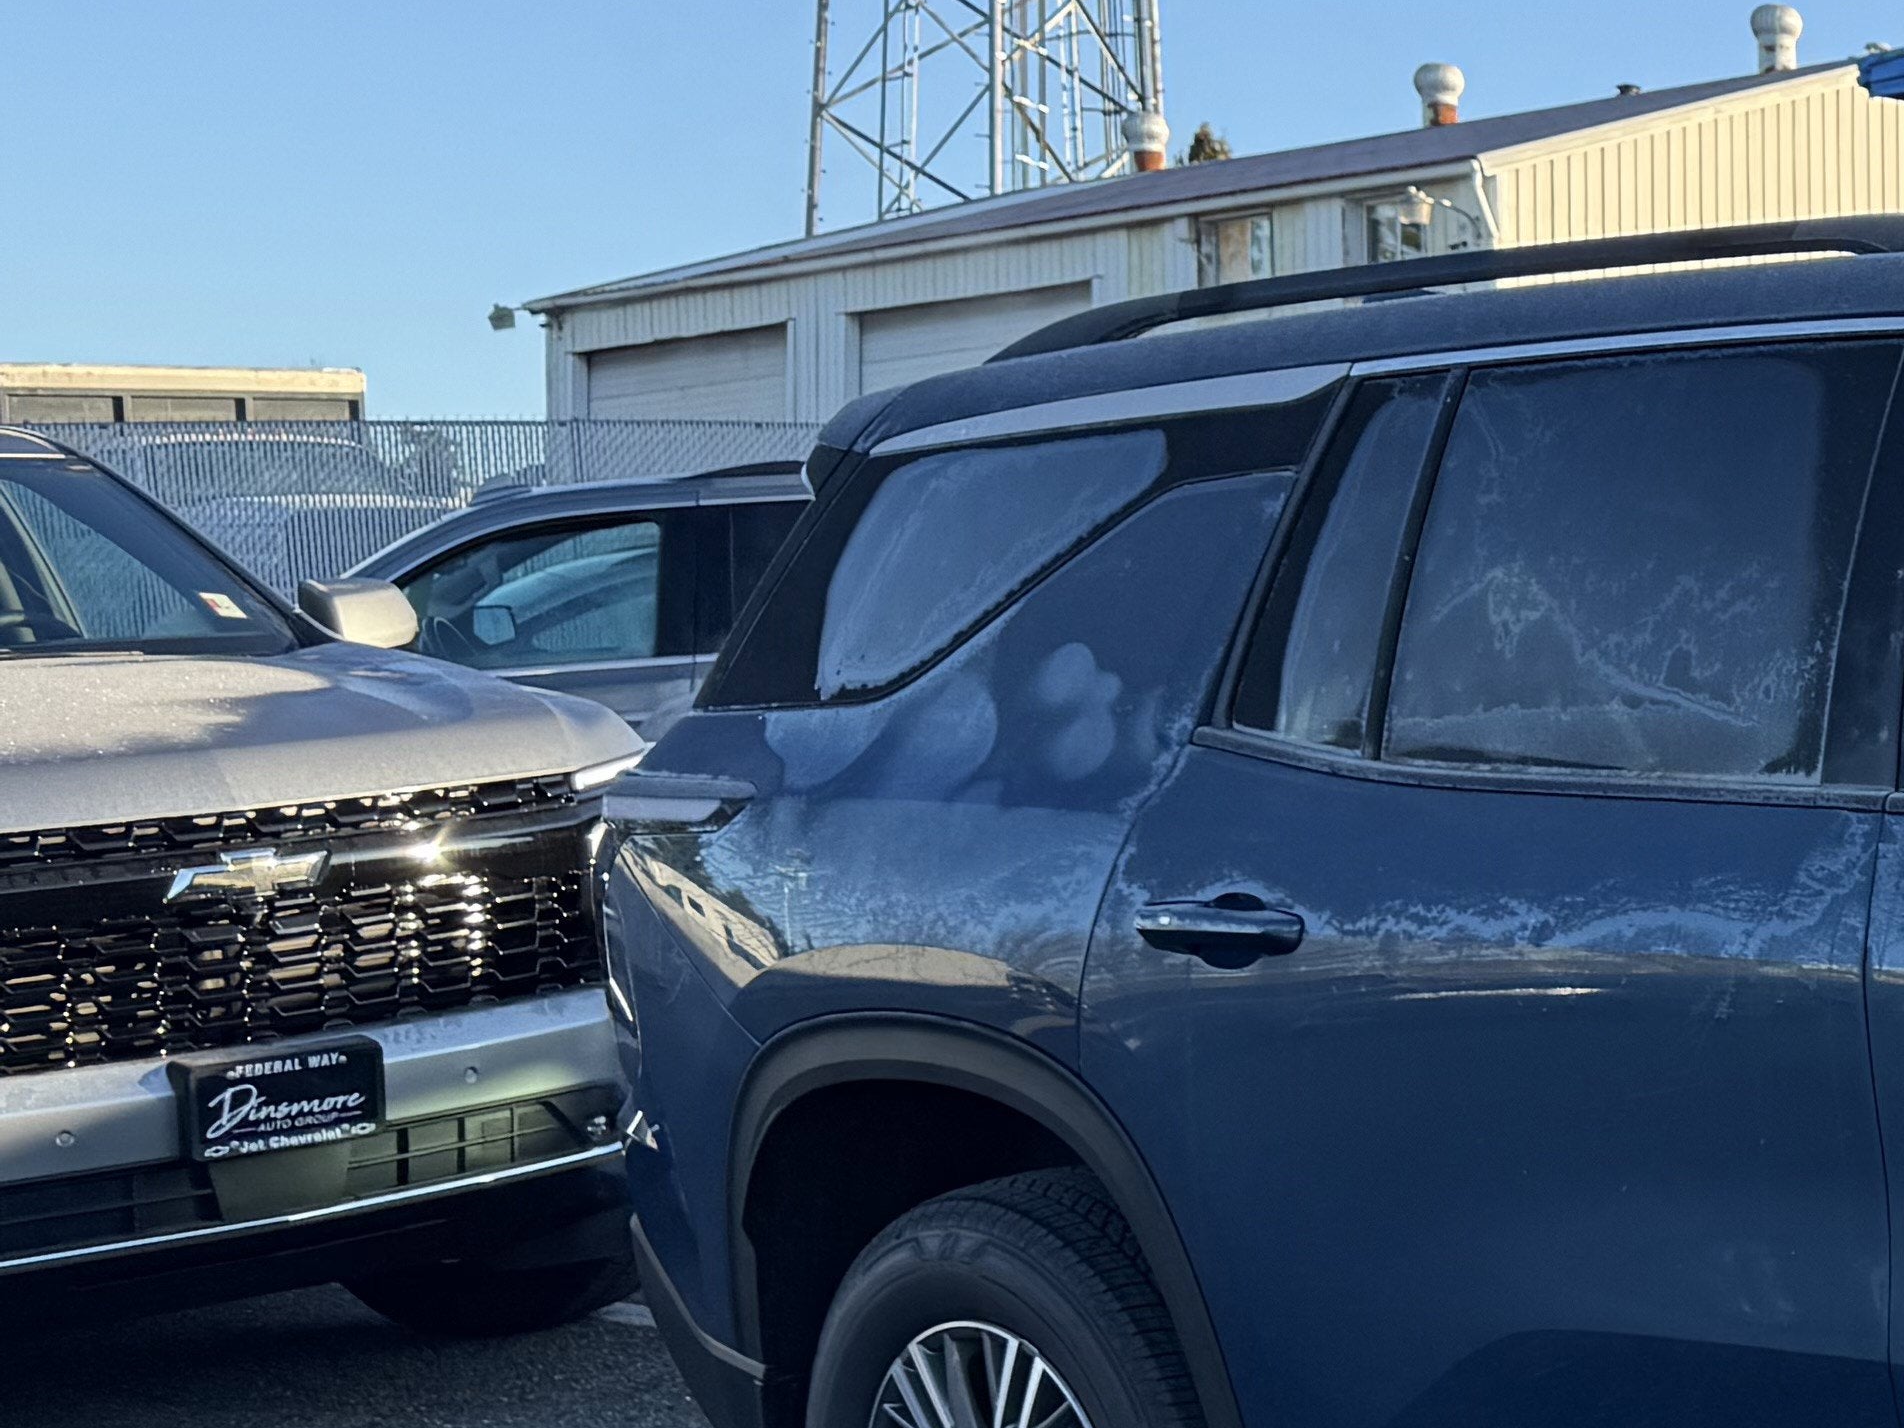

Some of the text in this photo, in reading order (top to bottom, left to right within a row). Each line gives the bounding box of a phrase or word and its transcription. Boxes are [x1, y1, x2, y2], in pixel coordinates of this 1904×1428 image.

[234, 1052, 339, 1079] FEDERAL WAY
[206, 1083, 367, 1139] Dinsmore
